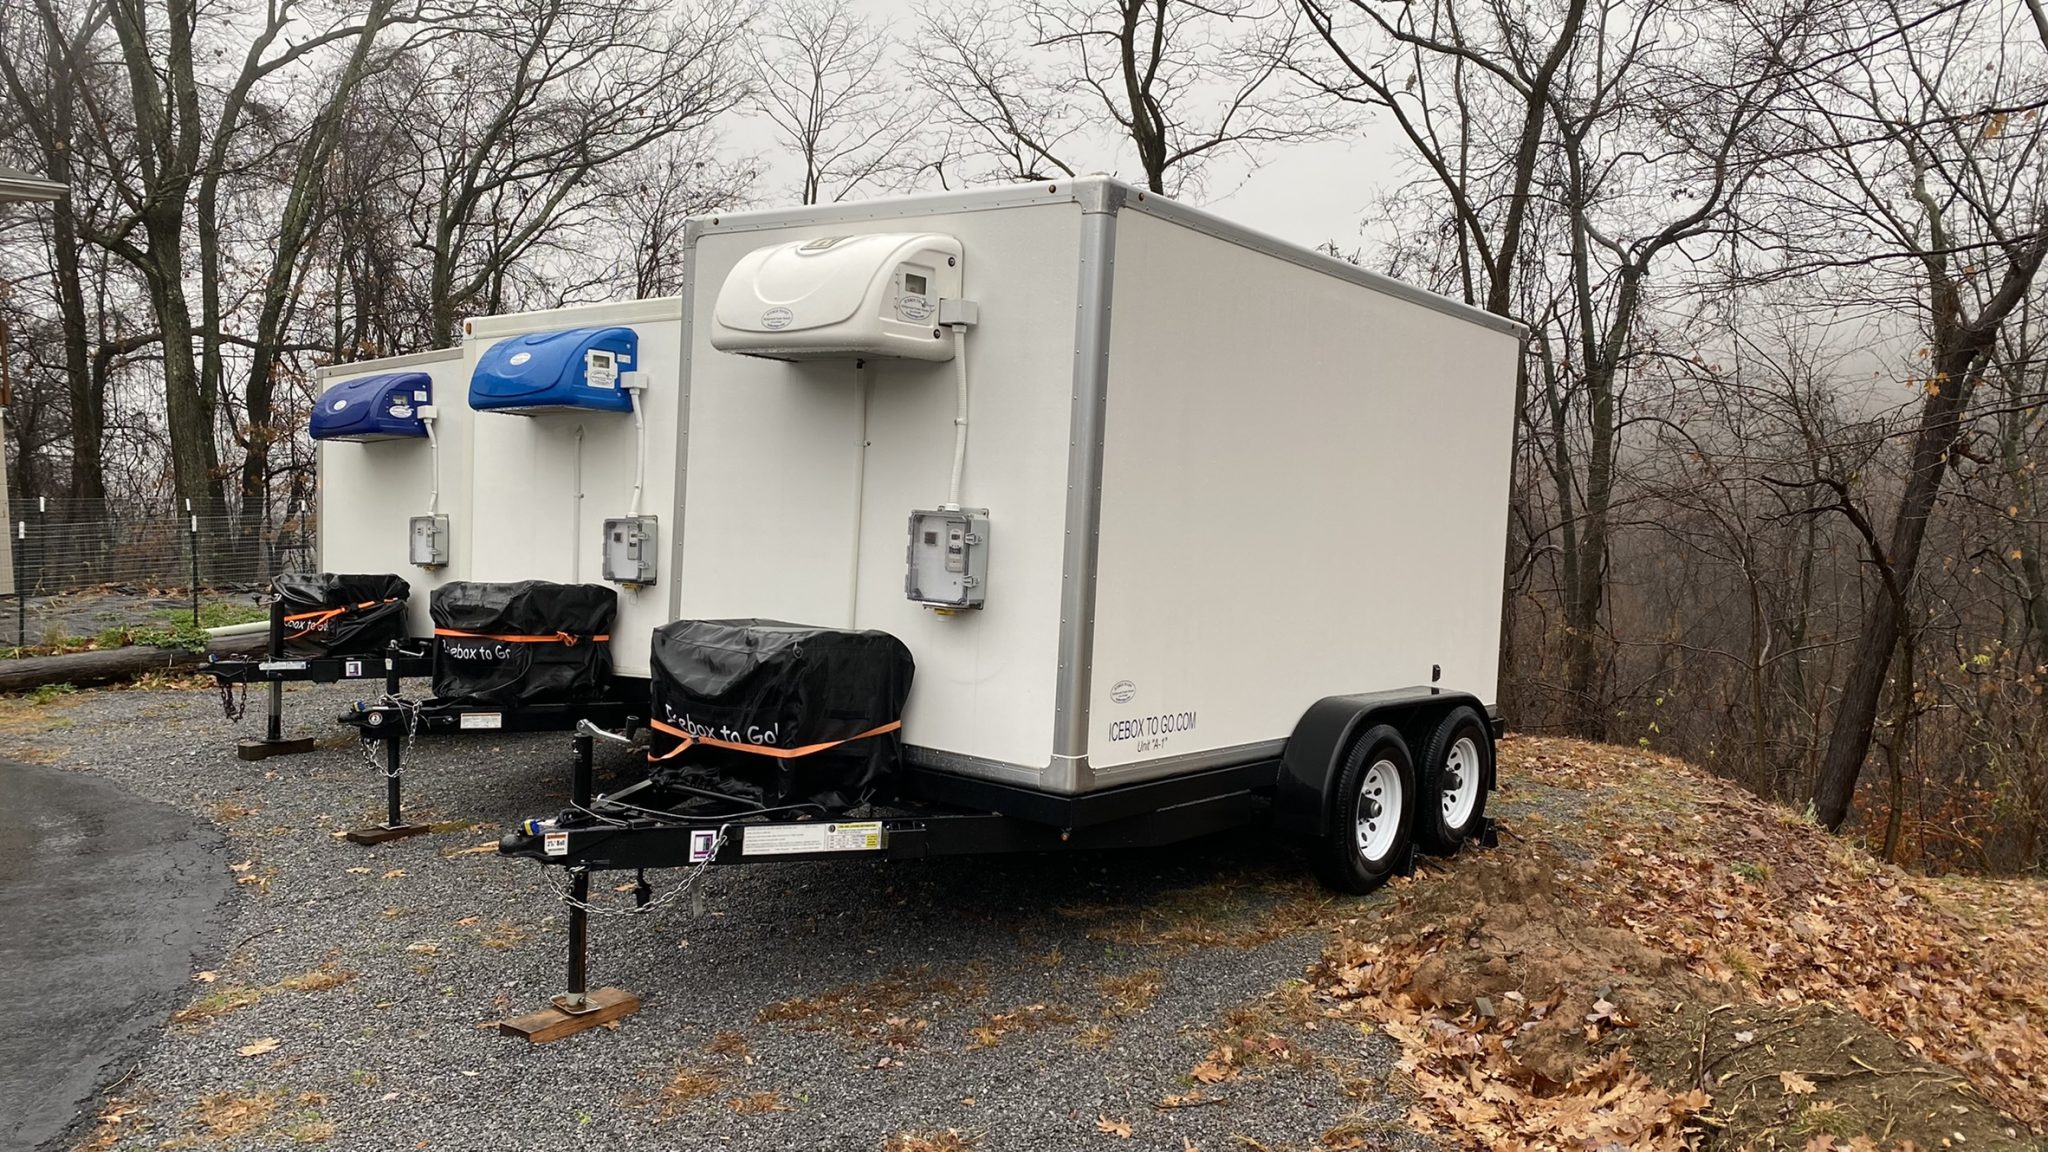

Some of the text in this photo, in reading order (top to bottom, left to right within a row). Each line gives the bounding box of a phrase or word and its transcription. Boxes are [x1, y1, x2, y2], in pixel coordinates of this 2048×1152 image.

[479, 646, 493, 660] to
[720, 725, 742, 744] to
[1109, 712, 1197, 742] ICEBOX TO GO.COM
[1137, 740, 1150, 752] Unit
